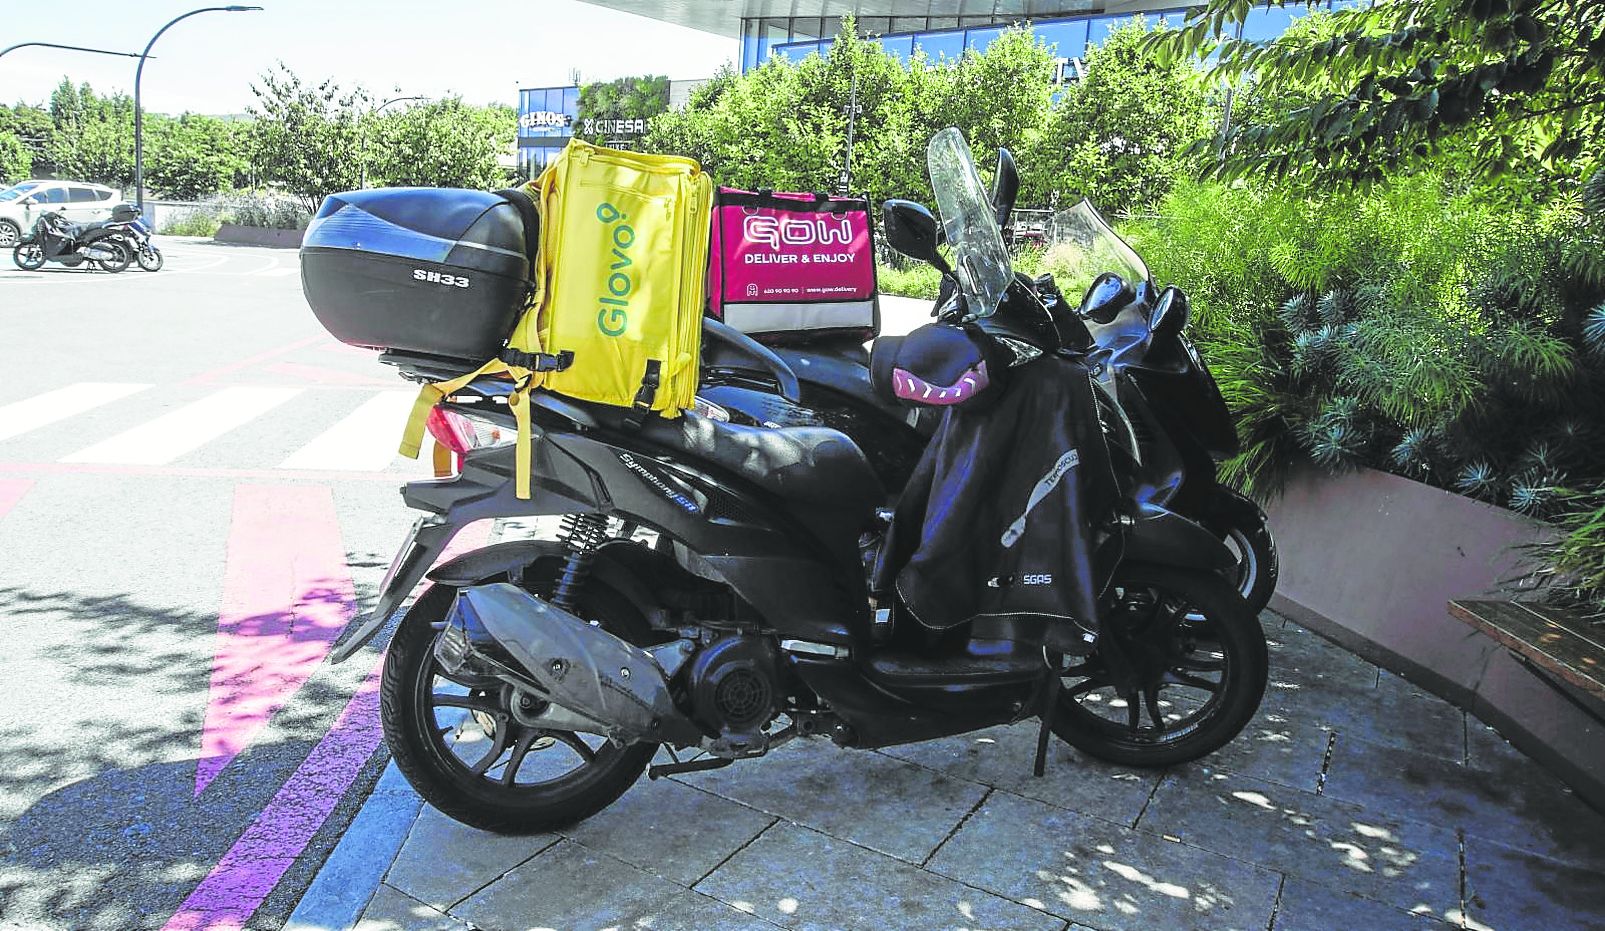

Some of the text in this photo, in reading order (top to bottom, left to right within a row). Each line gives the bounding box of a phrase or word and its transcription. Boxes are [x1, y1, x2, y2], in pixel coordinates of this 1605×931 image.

[595, 119, 644, 134] CINESA
[744, 253, 856, 264] DELIVER & ENJOY
[412, 269, 471, 288] SH33
[597, 224, 636, 337] Glovo
[619, 453, 677, 499] Symphony
[1023, 574, 1052, 585] SGAS
